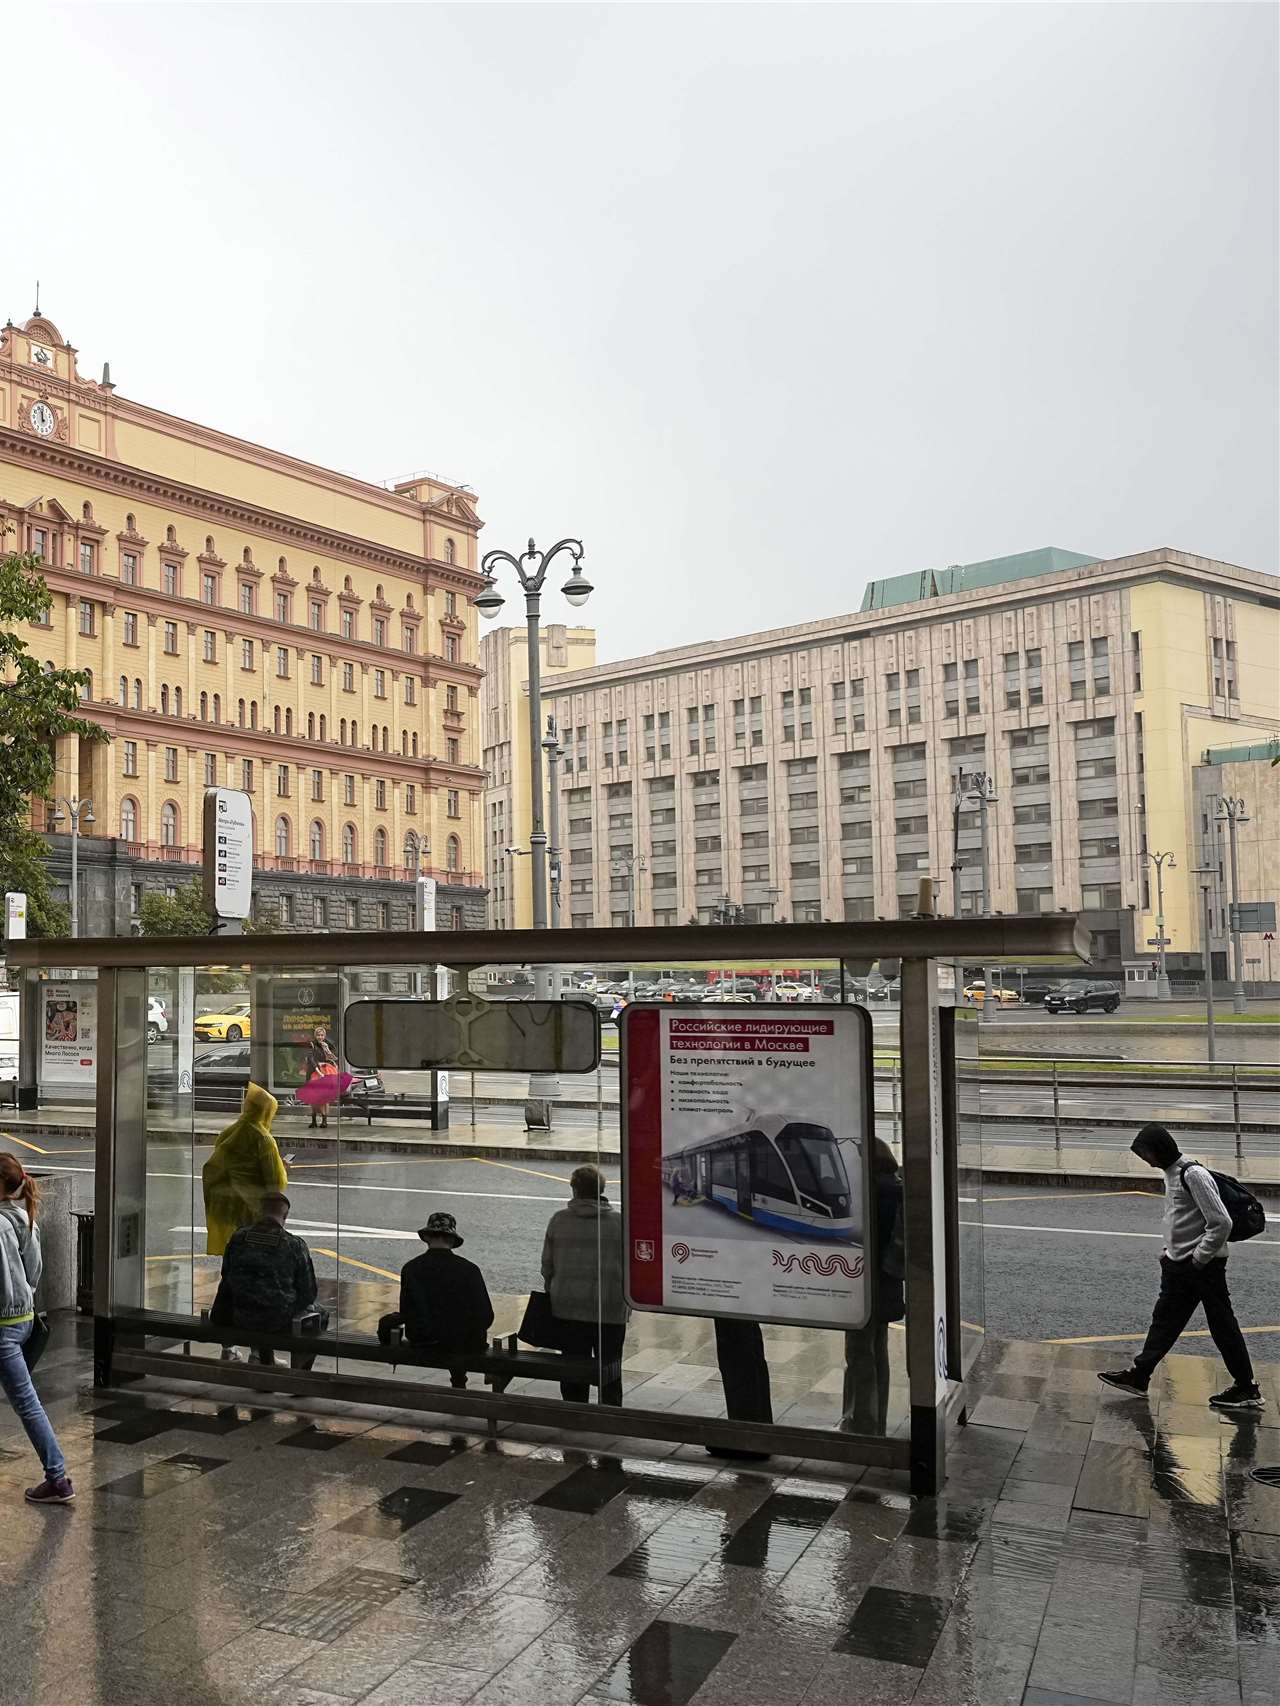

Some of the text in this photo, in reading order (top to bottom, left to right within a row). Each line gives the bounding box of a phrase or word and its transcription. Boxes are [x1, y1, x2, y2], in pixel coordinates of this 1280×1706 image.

[671, 1020, 828, 1035] Российские лидирующие
[671, 1040, 741, 1049] технологии
[754, 1039, 804, 1050] Москве
[670, 1055, 816, 1069] Без препятствий в будущее
